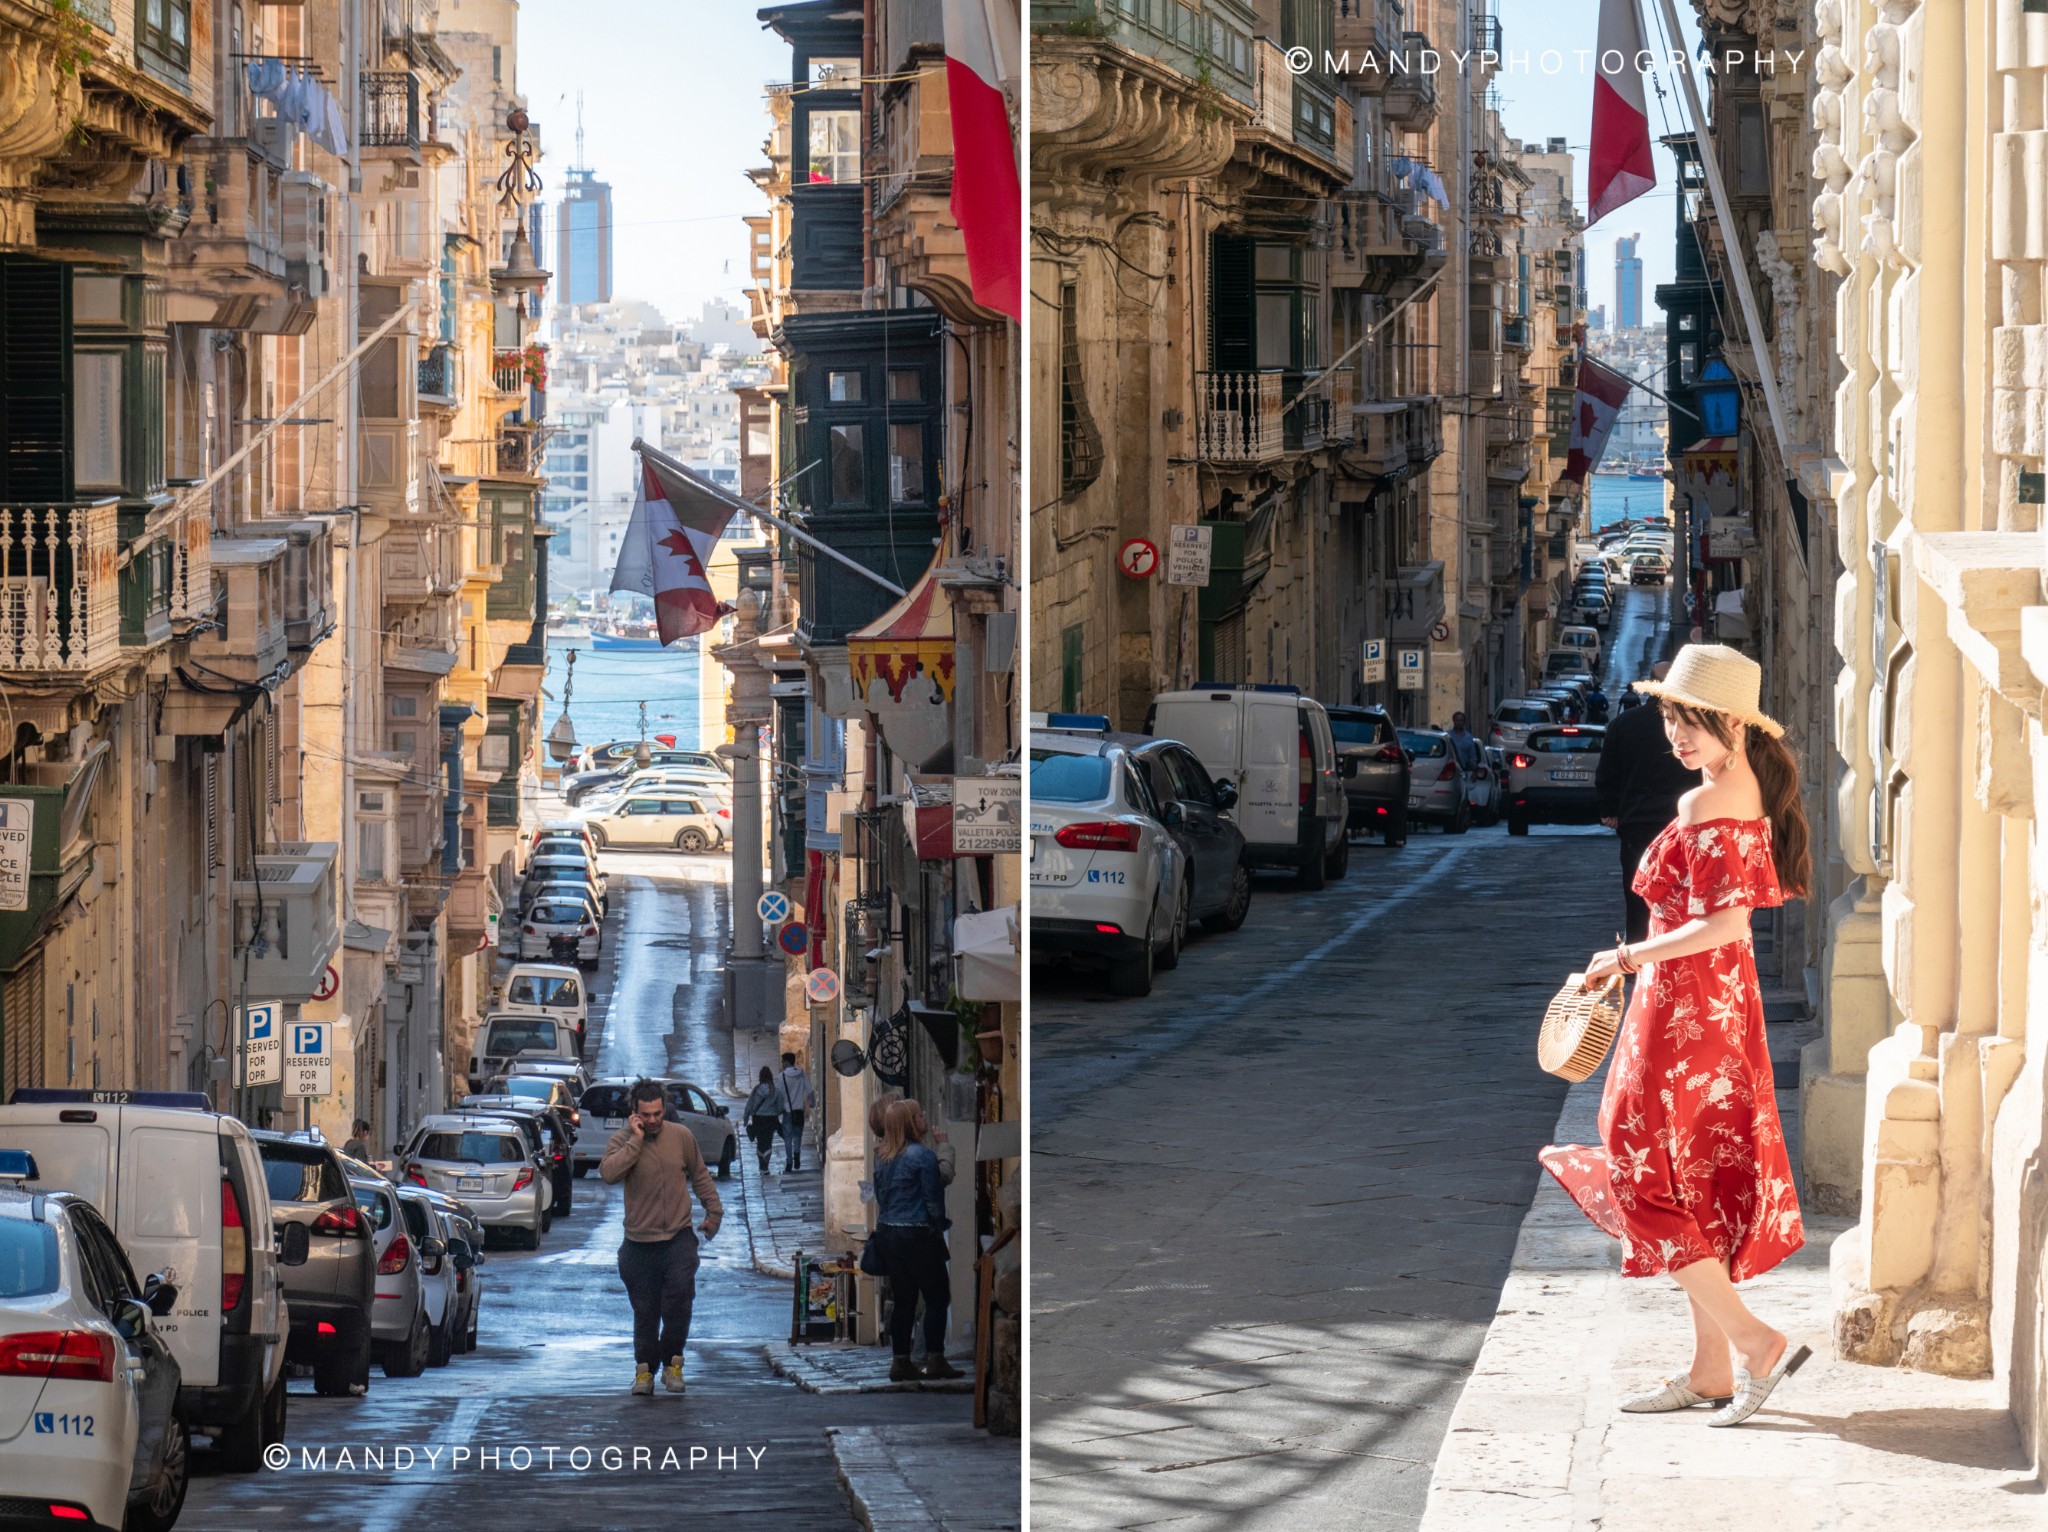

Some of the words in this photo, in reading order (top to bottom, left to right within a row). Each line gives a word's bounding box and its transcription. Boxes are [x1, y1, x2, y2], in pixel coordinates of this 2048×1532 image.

[1173, 542, 1208, 550] RESERVED
[1173, 564, 1205, 572] VEHICLE
[978, 787, 998, 797] TOW
[1000, 787, 1021, 797] ZON
[0, 832, 25, 841] VED
[957, 828, 995, 837] VALLETTA
[996, 828, 1021, 837] POLIC
[958, 839, 1021, 849] 21225495
[1053, 874, 1067, 882] PD
[1102, 871, 1125, 885] 112
[236, 1040, 280, 1055] RSERVED
[249, 1056, 266, 1067] FOR
[286, 1057, 330, 1067] RESERVED
[249, 1070, 266, 1081] OPR
[300, 1070, 317, 1080] FOR
[299, 1083, 317, 1093] OPR
[104, 1092, 128, 1104] 112
[176, 1309, 209, 1317] POLICE
[58, 1413, 94, 1436] 112
